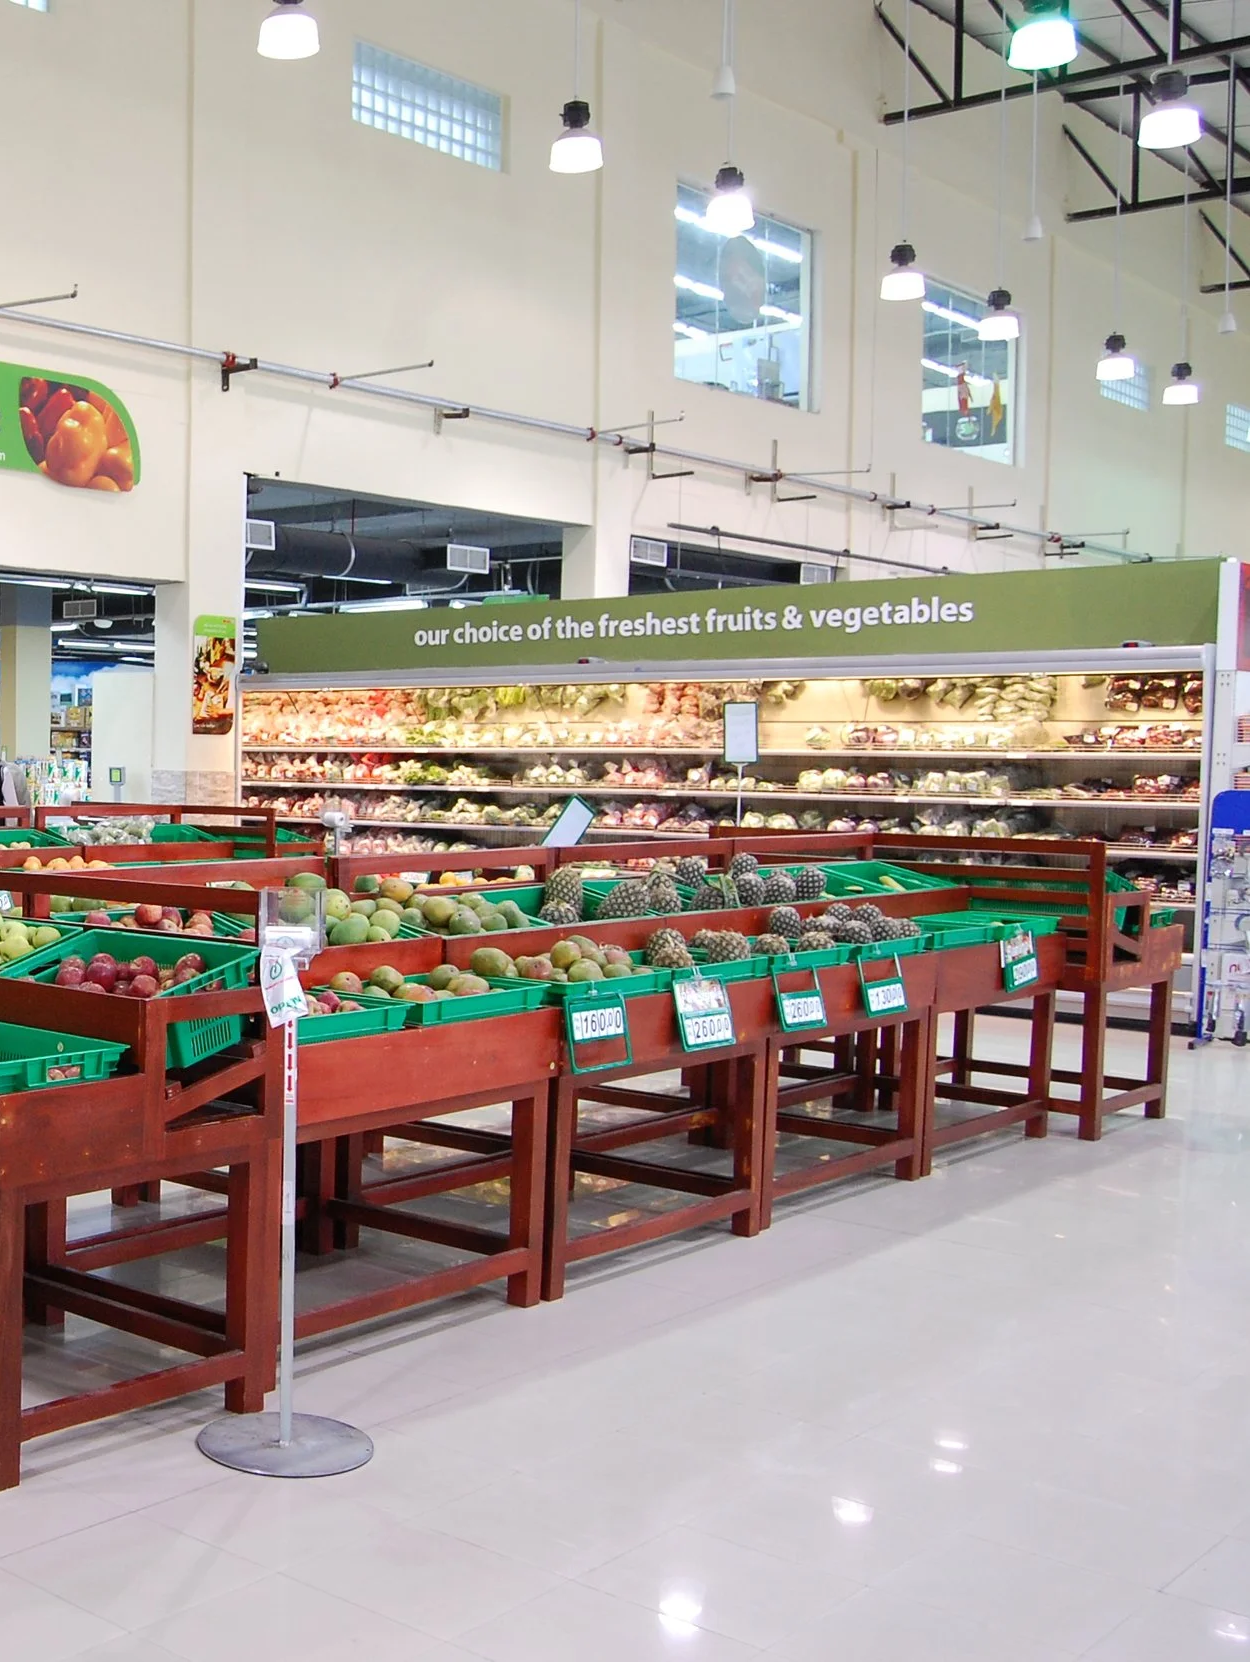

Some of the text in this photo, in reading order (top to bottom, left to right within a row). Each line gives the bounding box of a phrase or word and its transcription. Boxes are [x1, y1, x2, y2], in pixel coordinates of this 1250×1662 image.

[414, 596, 974, 647] our choice of the freshest fruits & vegetables
[583, 1010, 622, 1036] 160.00
[694, 1017, 730, 1039] 260.00
